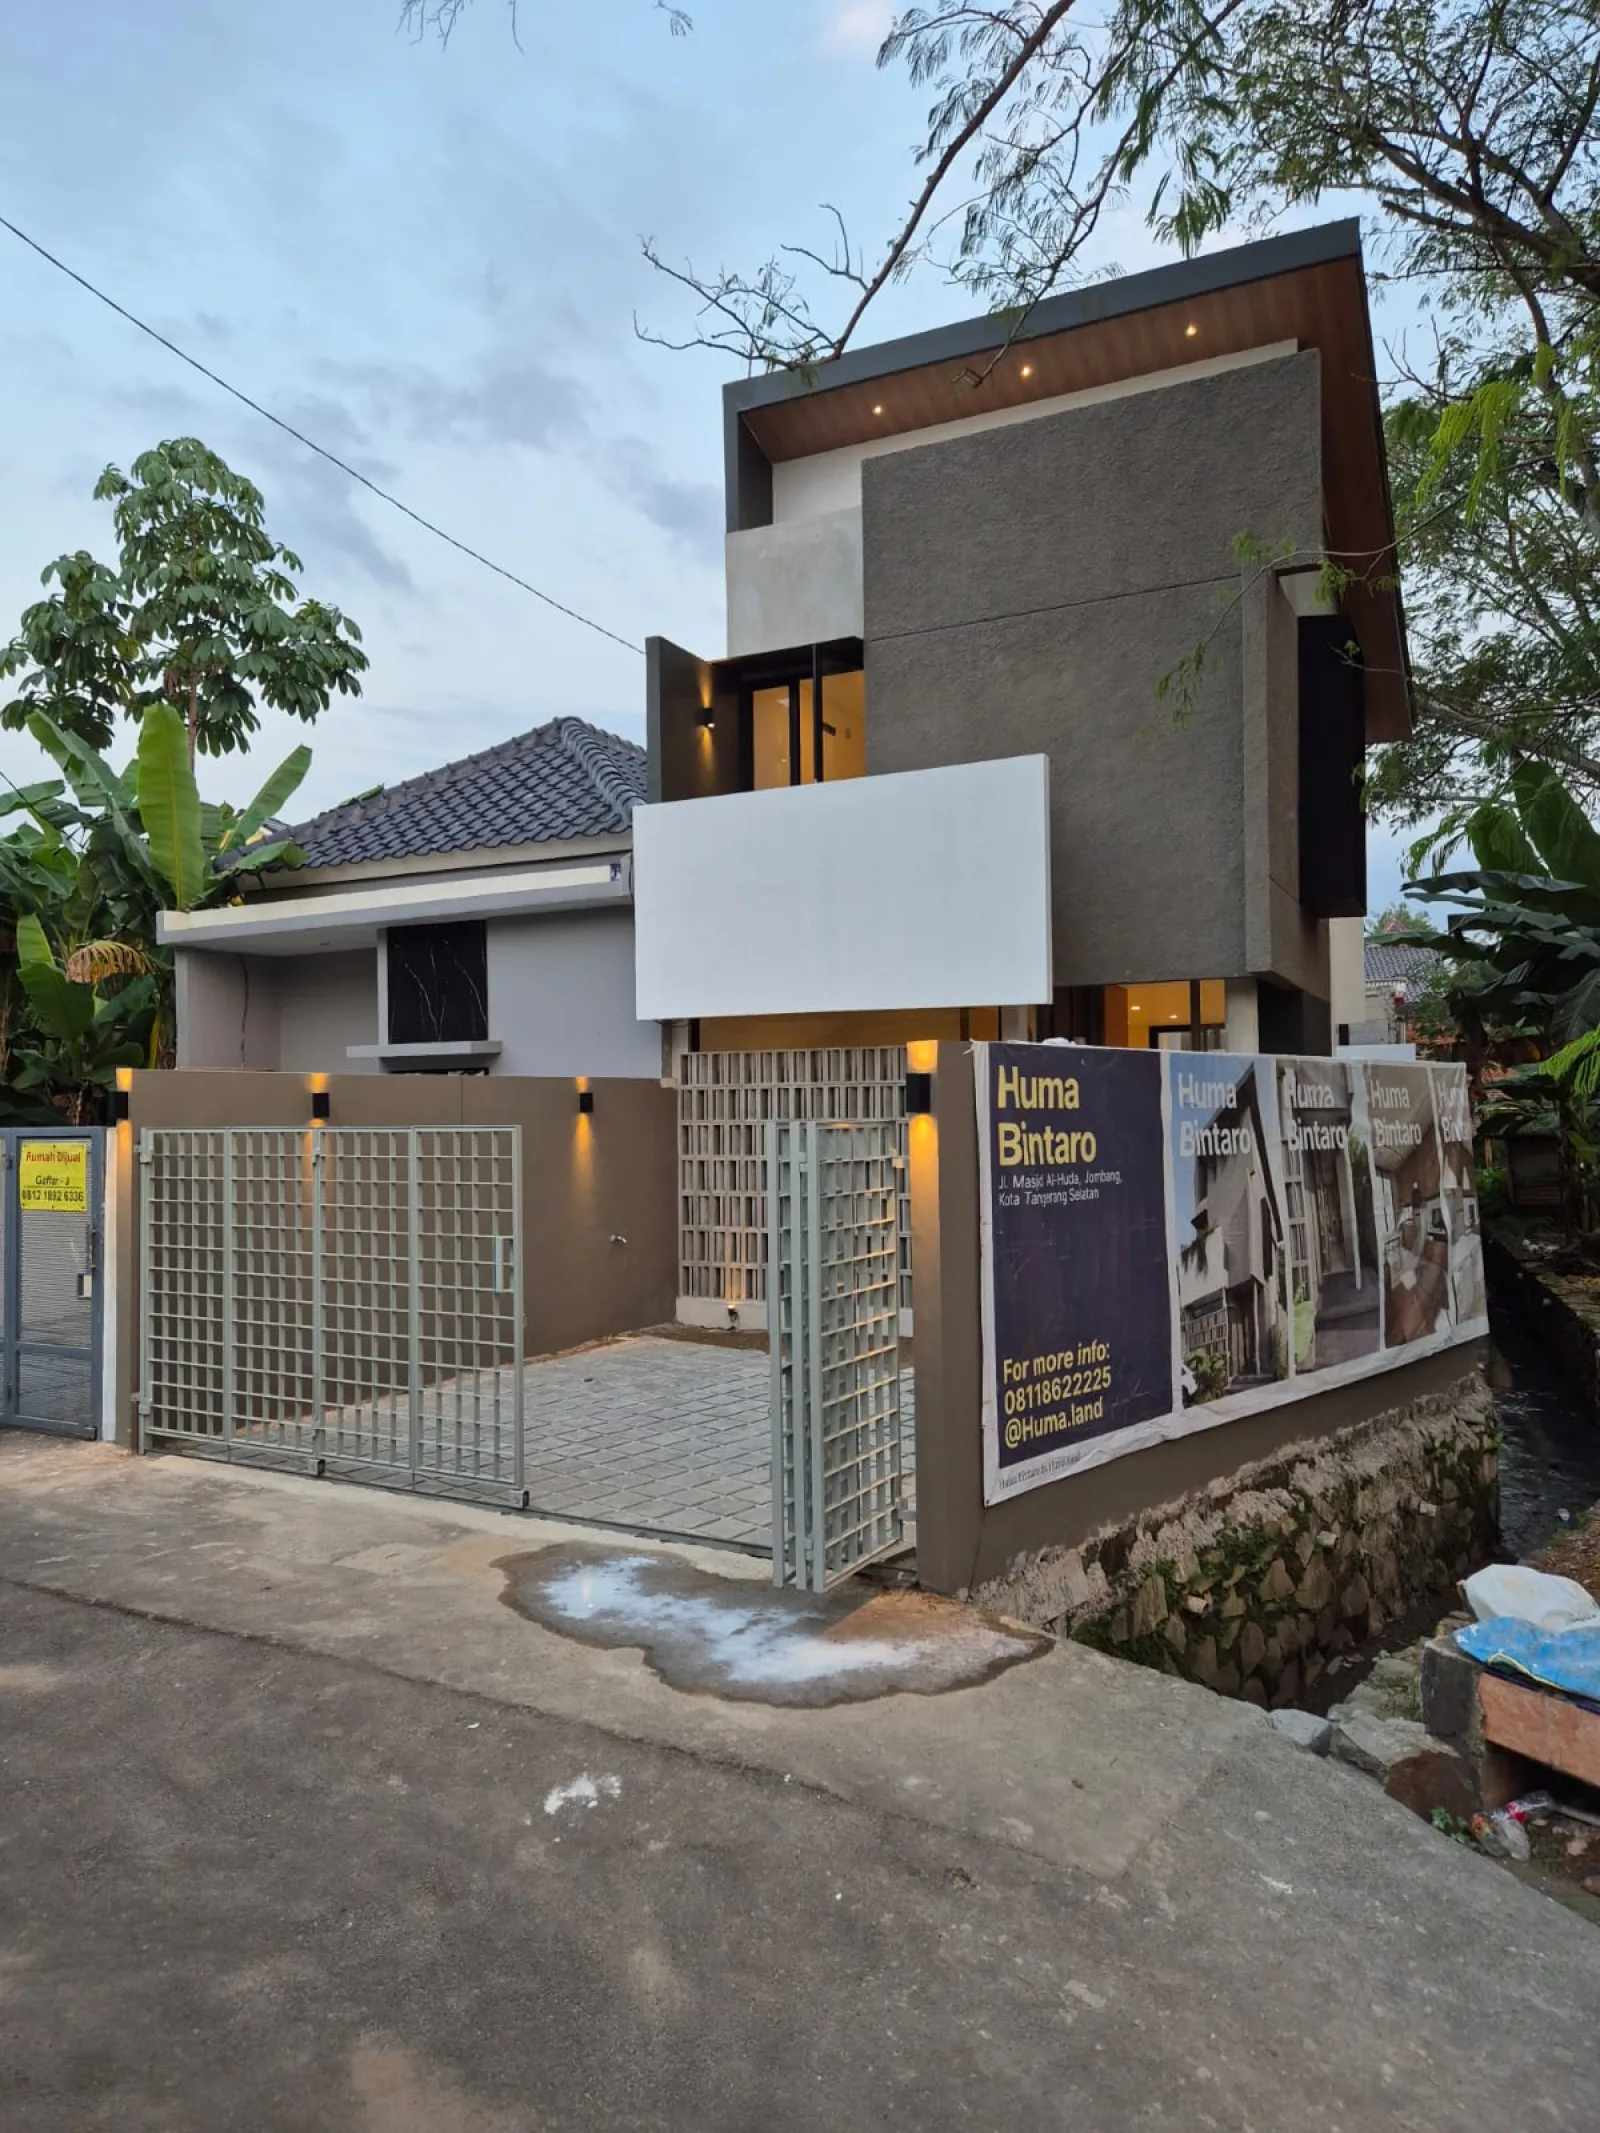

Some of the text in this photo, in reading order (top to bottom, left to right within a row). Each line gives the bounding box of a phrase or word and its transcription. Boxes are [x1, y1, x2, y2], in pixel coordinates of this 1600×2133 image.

[996, 1064, 1080, 1110] Huma
[1178, 1072, 1237, 1109] Huma
[1285, 1077, 1334, 1109] Huma
[1370, 1079, 1410, 1109] Huma
[998, 1121, 1097, 1167] Bintaro
[1180, 1119, 1251, 1156] Bintaro
[1287, 1117, 1347, 1151] Bintaro
[1374, 1117, 1422, 1147] Bintaro
[999, 1187, 1100, 1207] Kota Tangerang Selatan
[1012, 1173, 1044, 1191] Masjid
[1003, 1338, 1111, 1384] For more info:
[1004, 1365, 1112, 1415] 08118622225
[1005, 1395, 1104, 1449] @Huma.land
